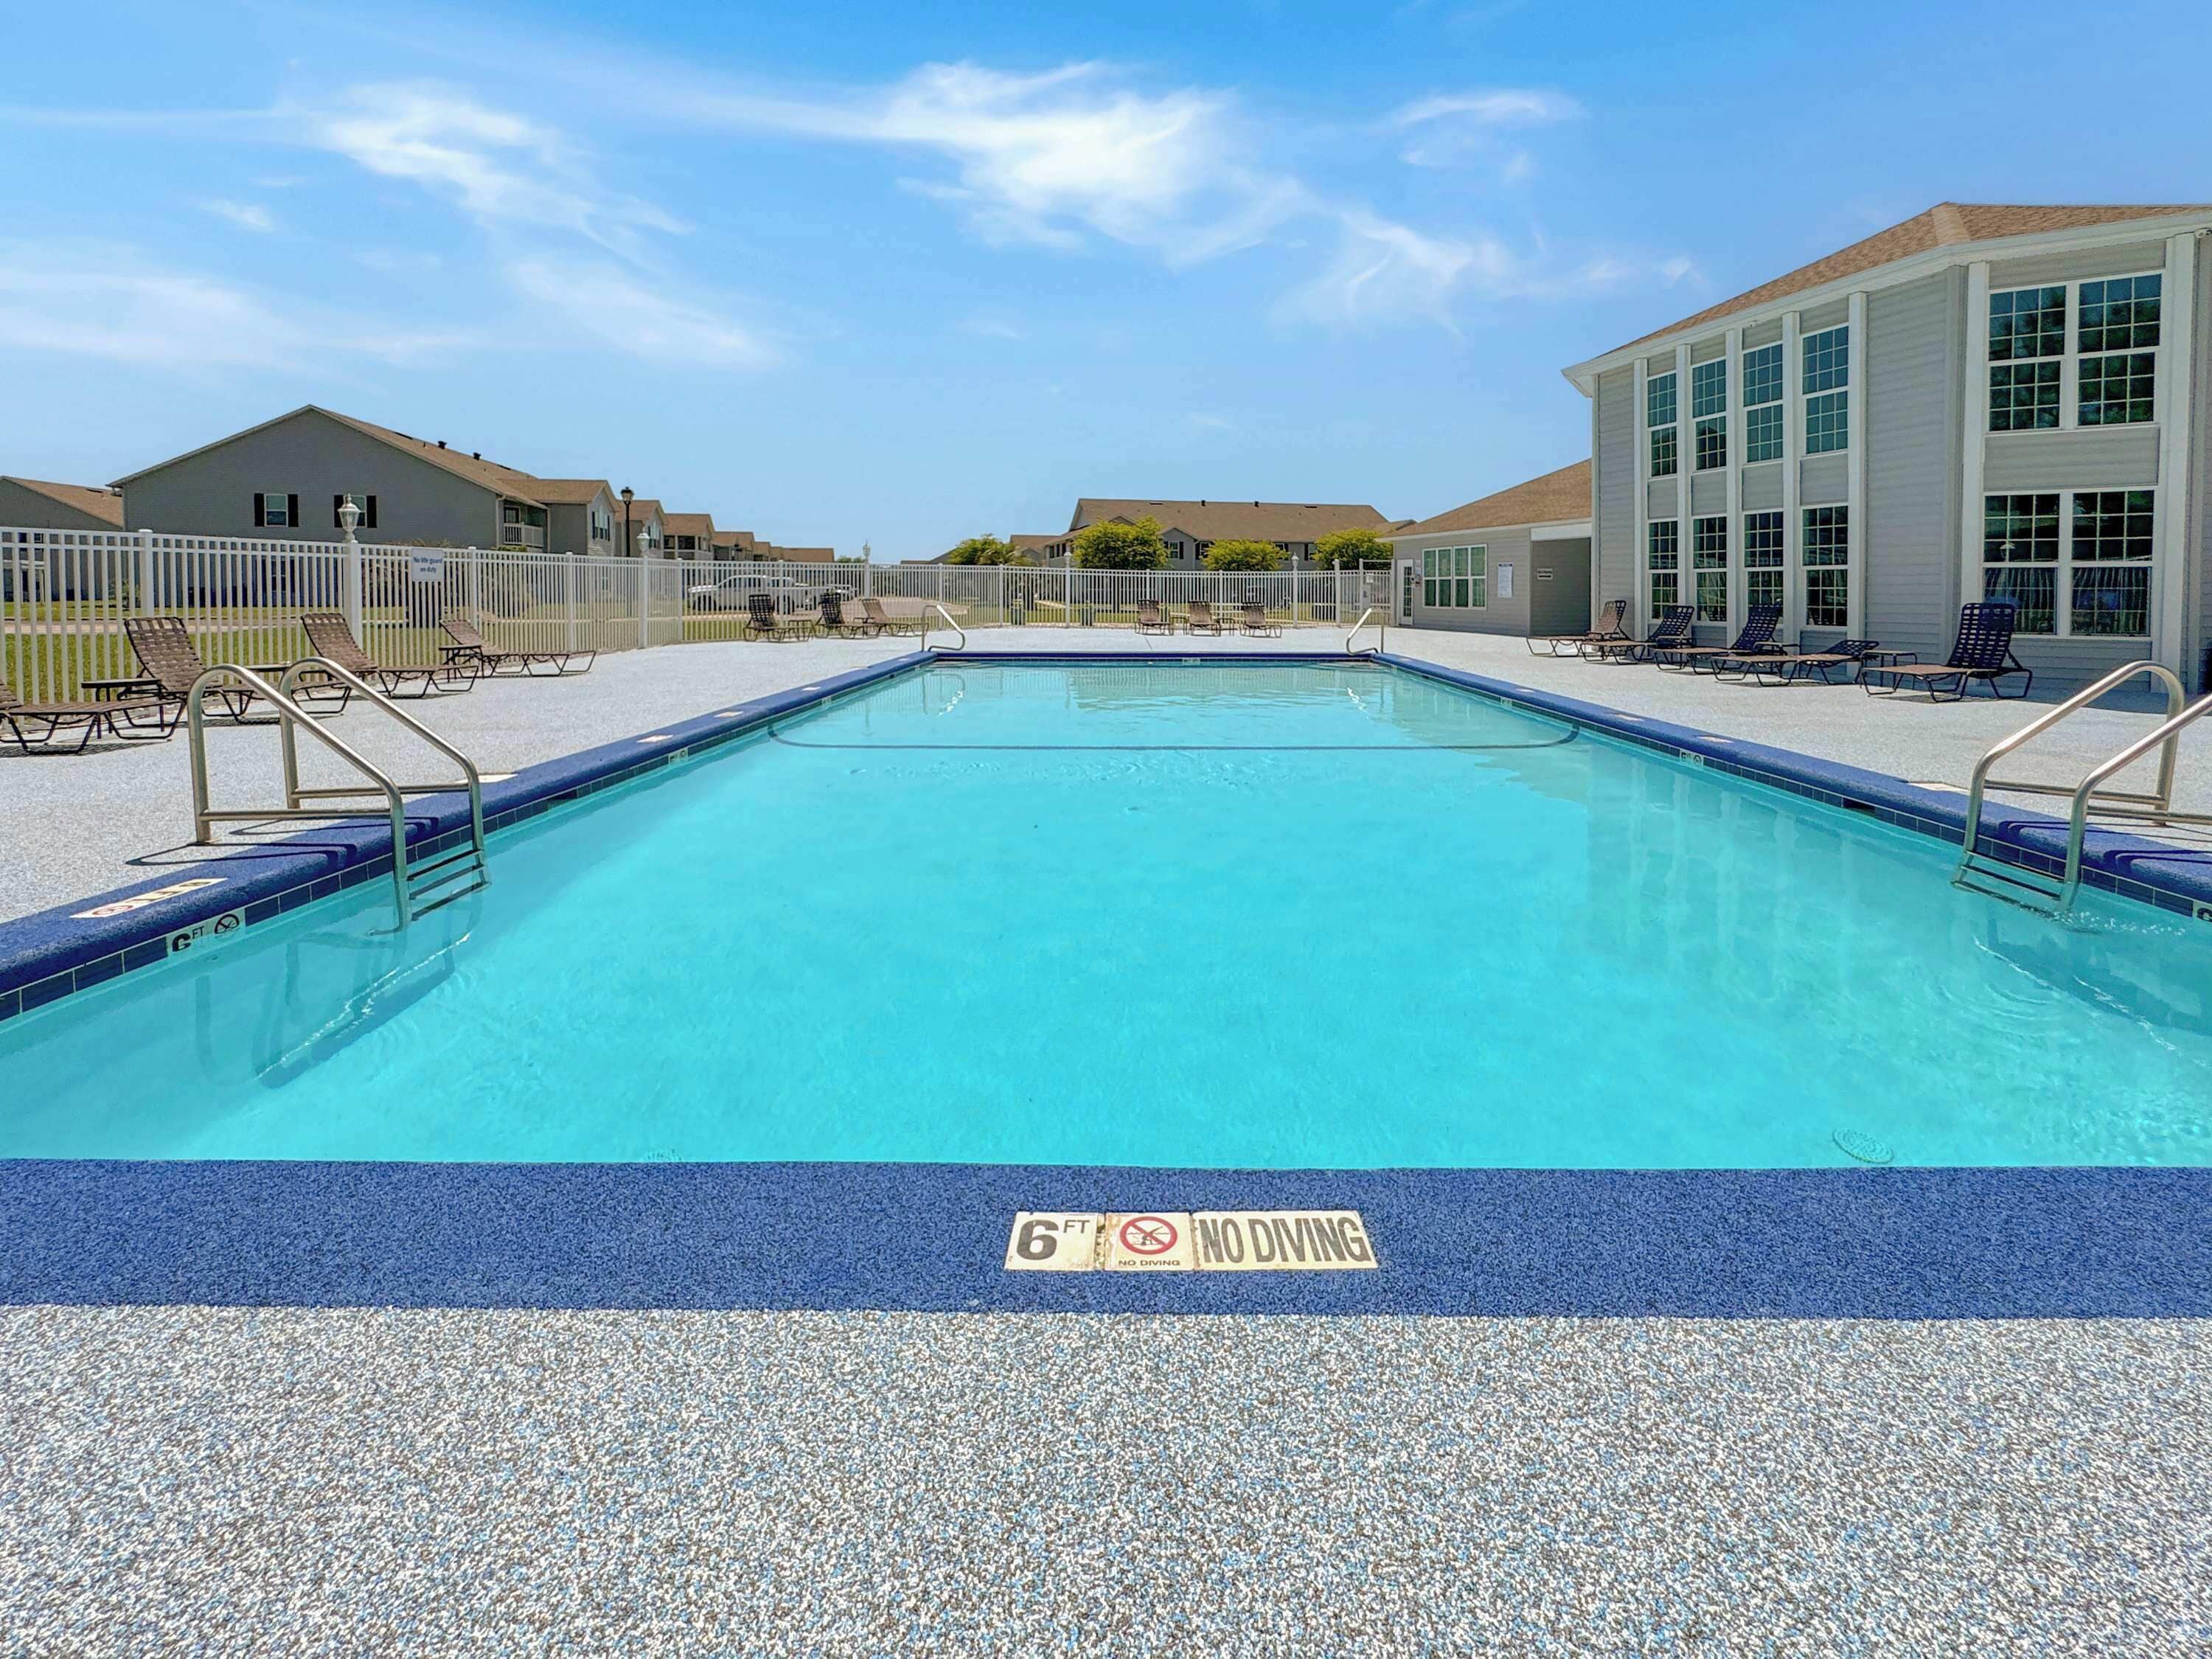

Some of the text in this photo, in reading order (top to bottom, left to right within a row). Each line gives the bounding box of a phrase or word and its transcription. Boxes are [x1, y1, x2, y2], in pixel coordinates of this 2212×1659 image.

[427, 566, 437, 574] duty
[192, 926, 205, 939] FT
[1016, 1219, 1091, 1261] 6 FT
[1198, 1217, 1372, 1264] NO DIVING
